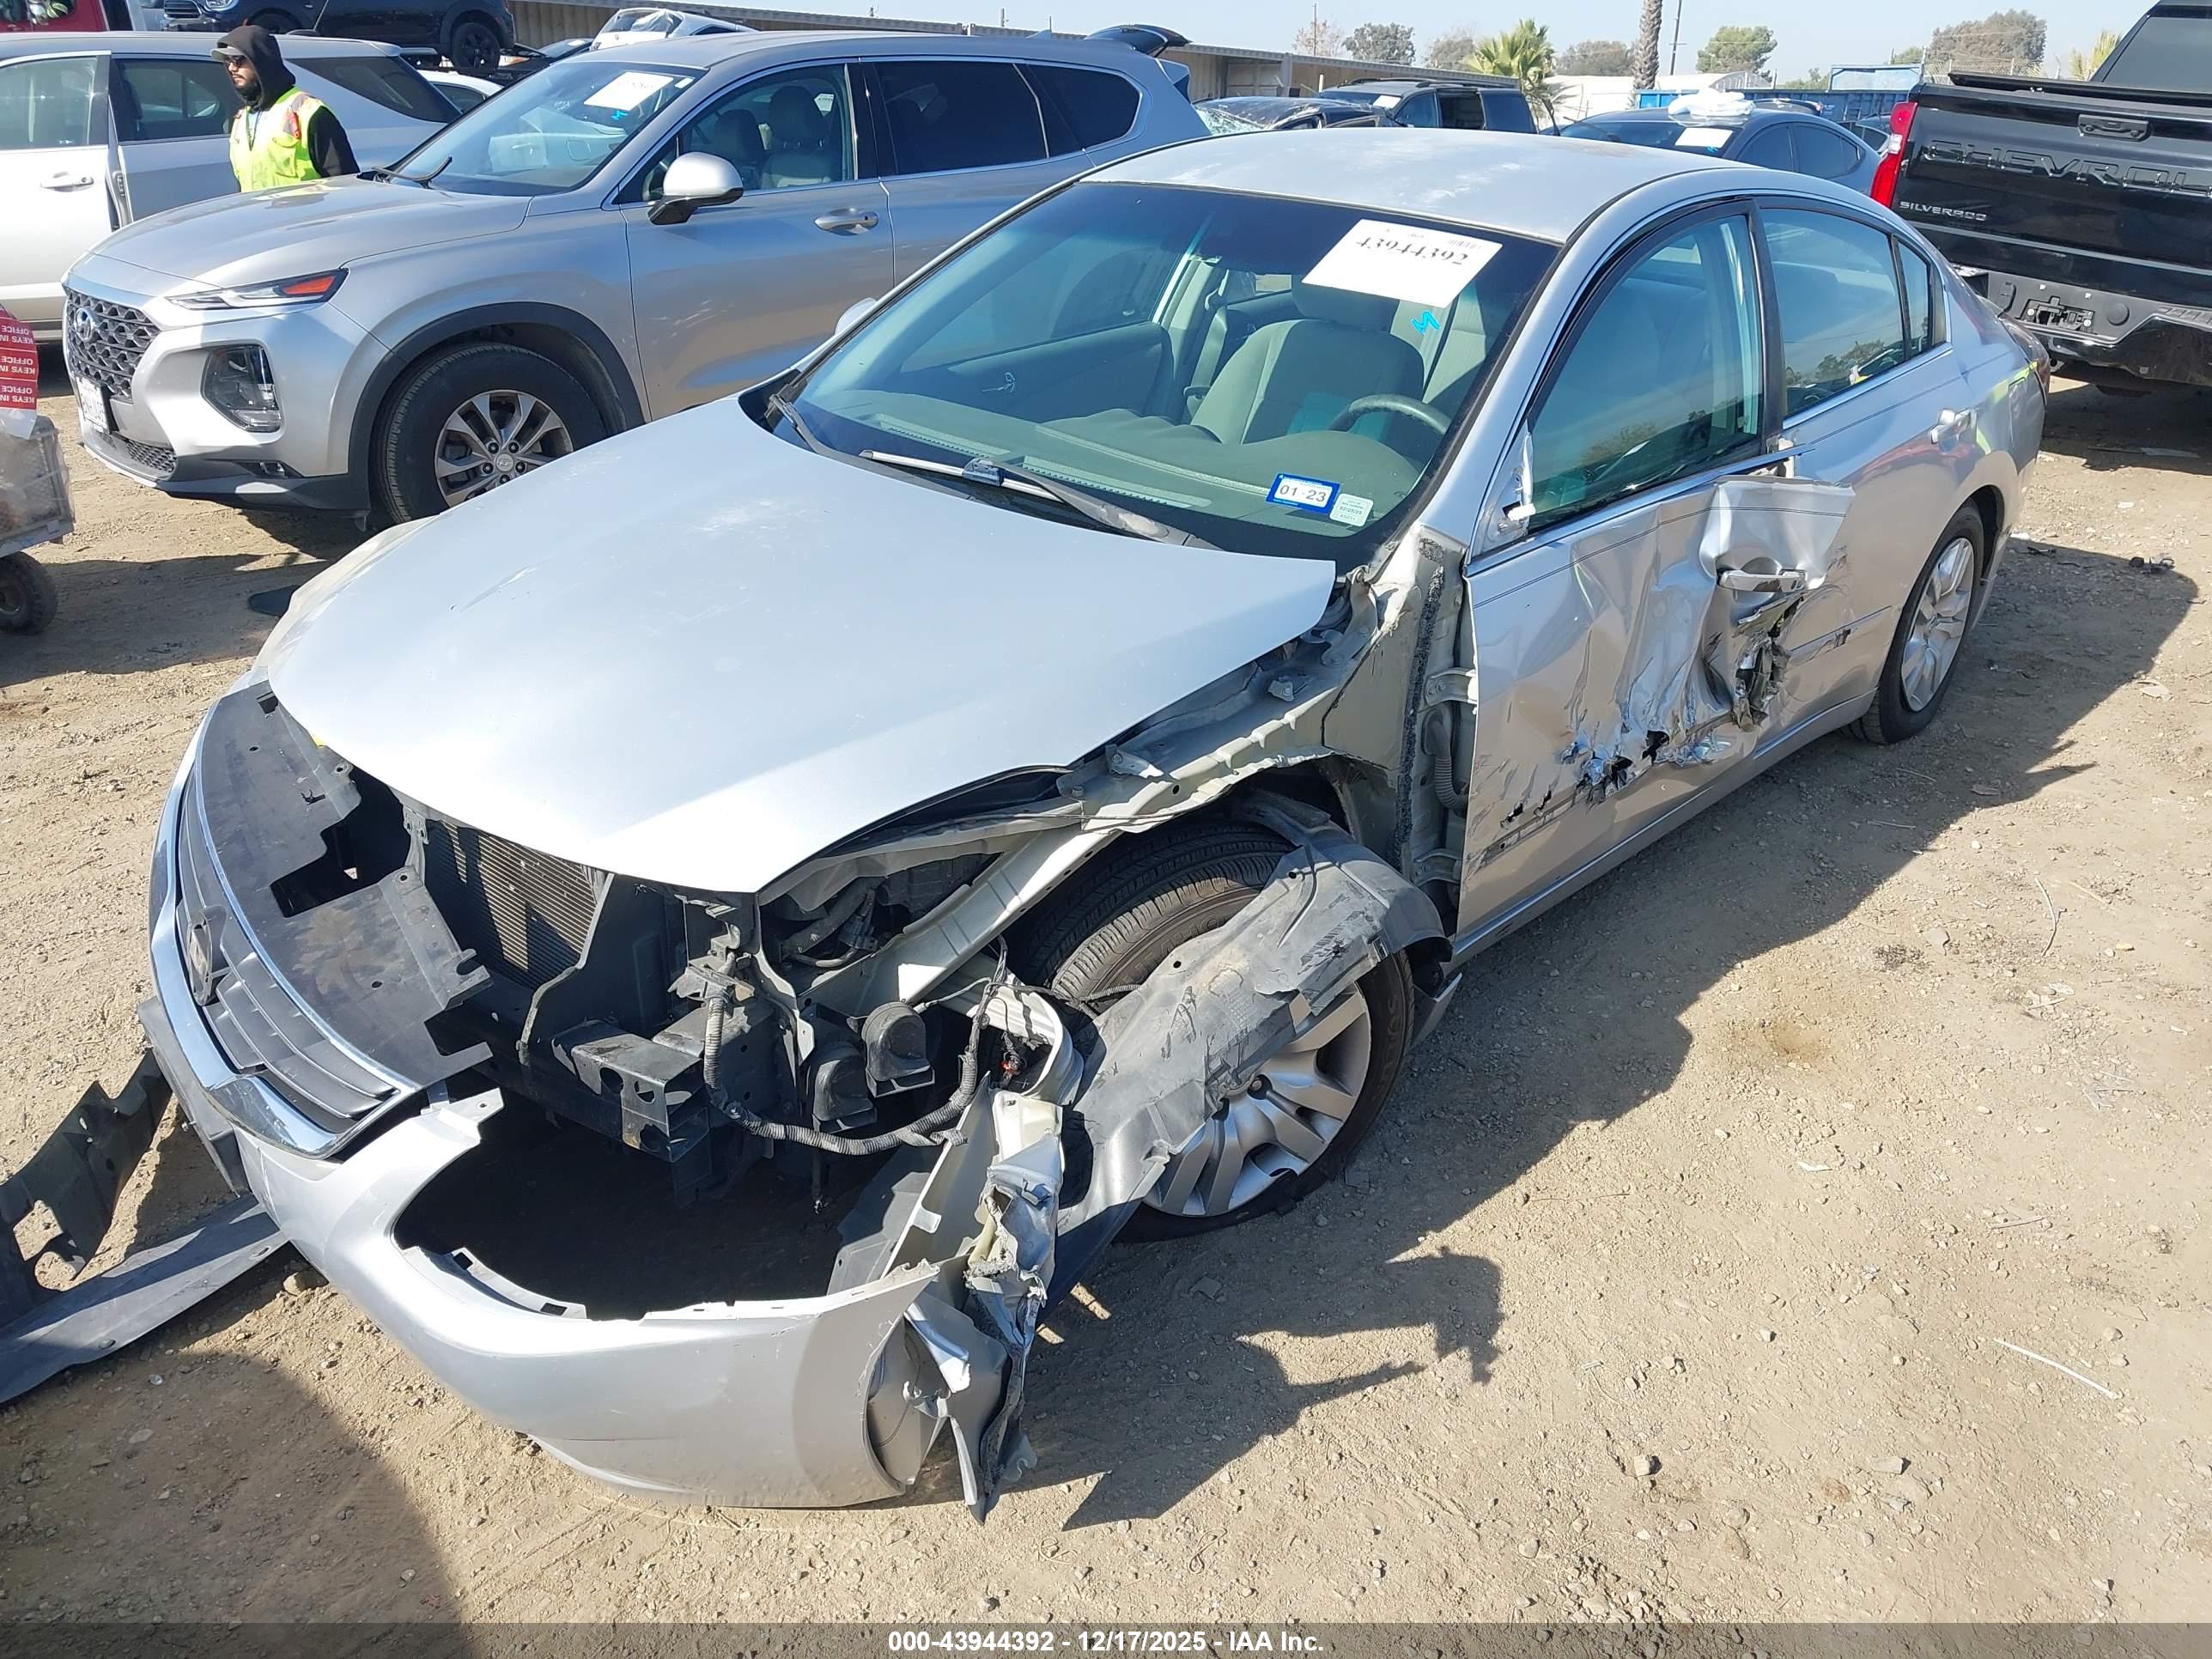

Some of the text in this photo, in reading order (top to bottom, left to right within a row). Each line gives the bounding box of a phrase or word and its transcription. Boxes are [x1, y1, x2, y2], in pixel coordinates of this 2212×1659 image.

[1899, 201, 1987, 222] SILVERADO
[1356, 236, 1468, 264] 43944392
[2, 325, 29, 336] OFFICE
[11, 336, 33, 344] KEYS
[1, 356, 33, 366] OFFICE
[11, 365, 35, 375] KEYS
[1, 385, 33, 394] OFFICE
[12, 394, 34, 404] KEYS
[1279, 484, 1298, 497] 01
[1305, 488, 1328, 502] 23
